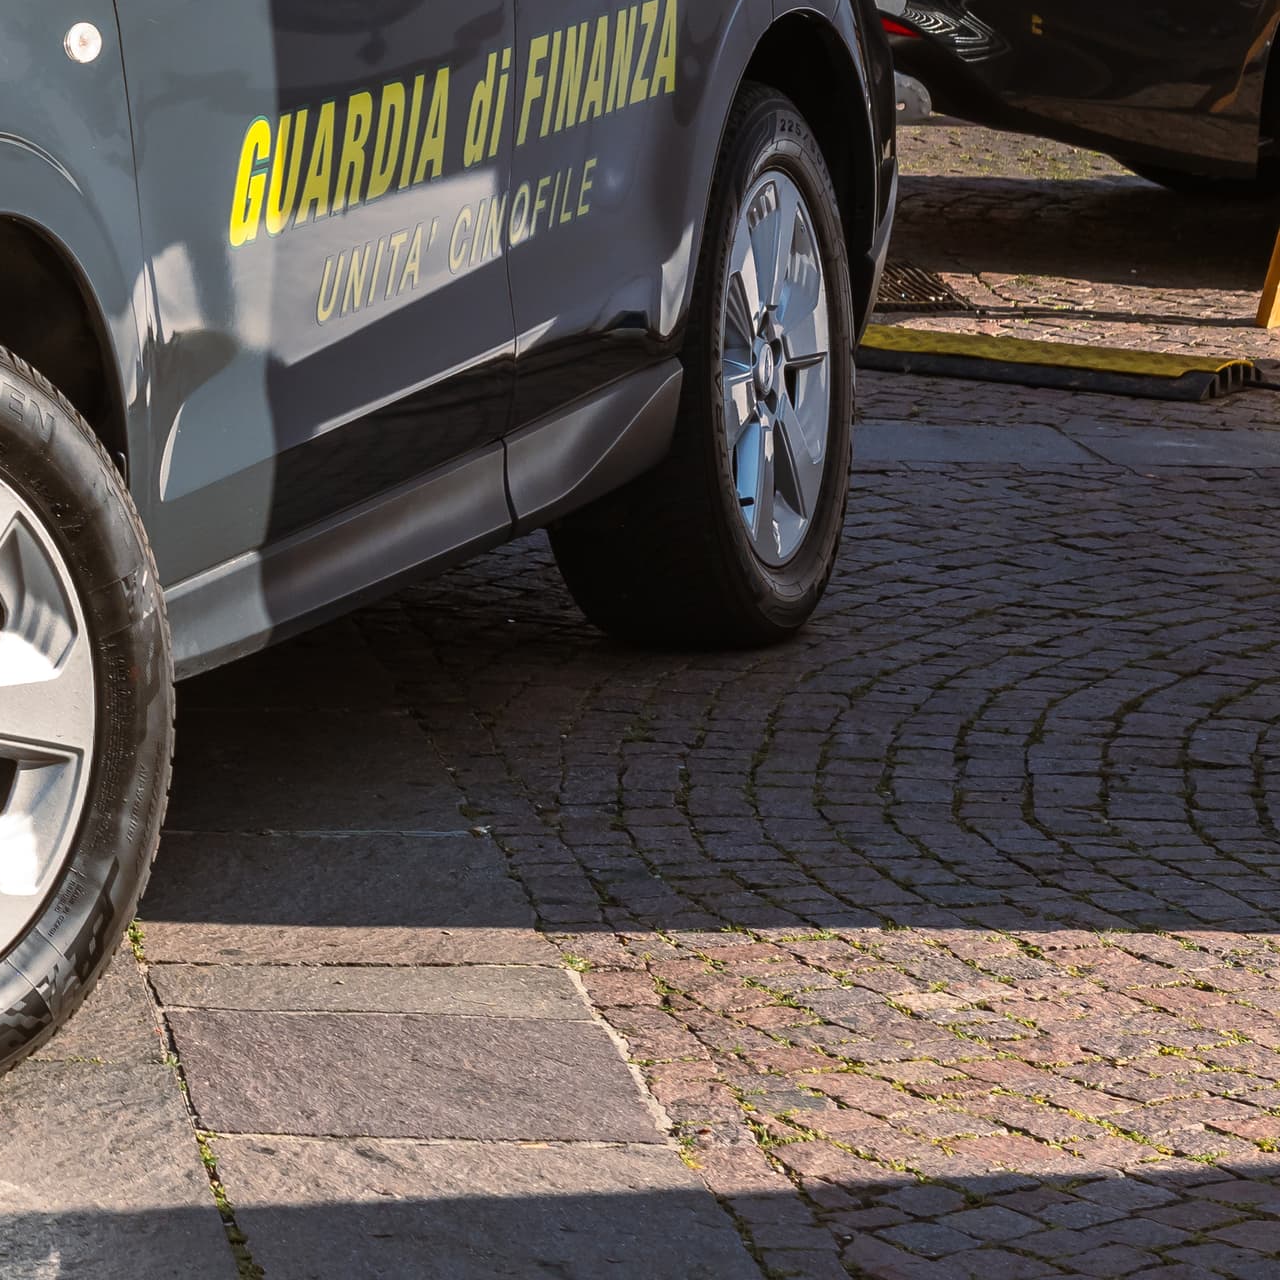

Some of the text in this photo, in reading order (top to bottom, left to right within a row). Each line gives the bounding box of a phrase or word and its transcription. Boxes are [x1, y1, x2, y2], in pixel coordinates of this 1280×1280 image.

[228, 66, 449, 248] GUARDIA
[462, 47, 511, 169] di
[447, 158, 598, 276] CINOFILE
